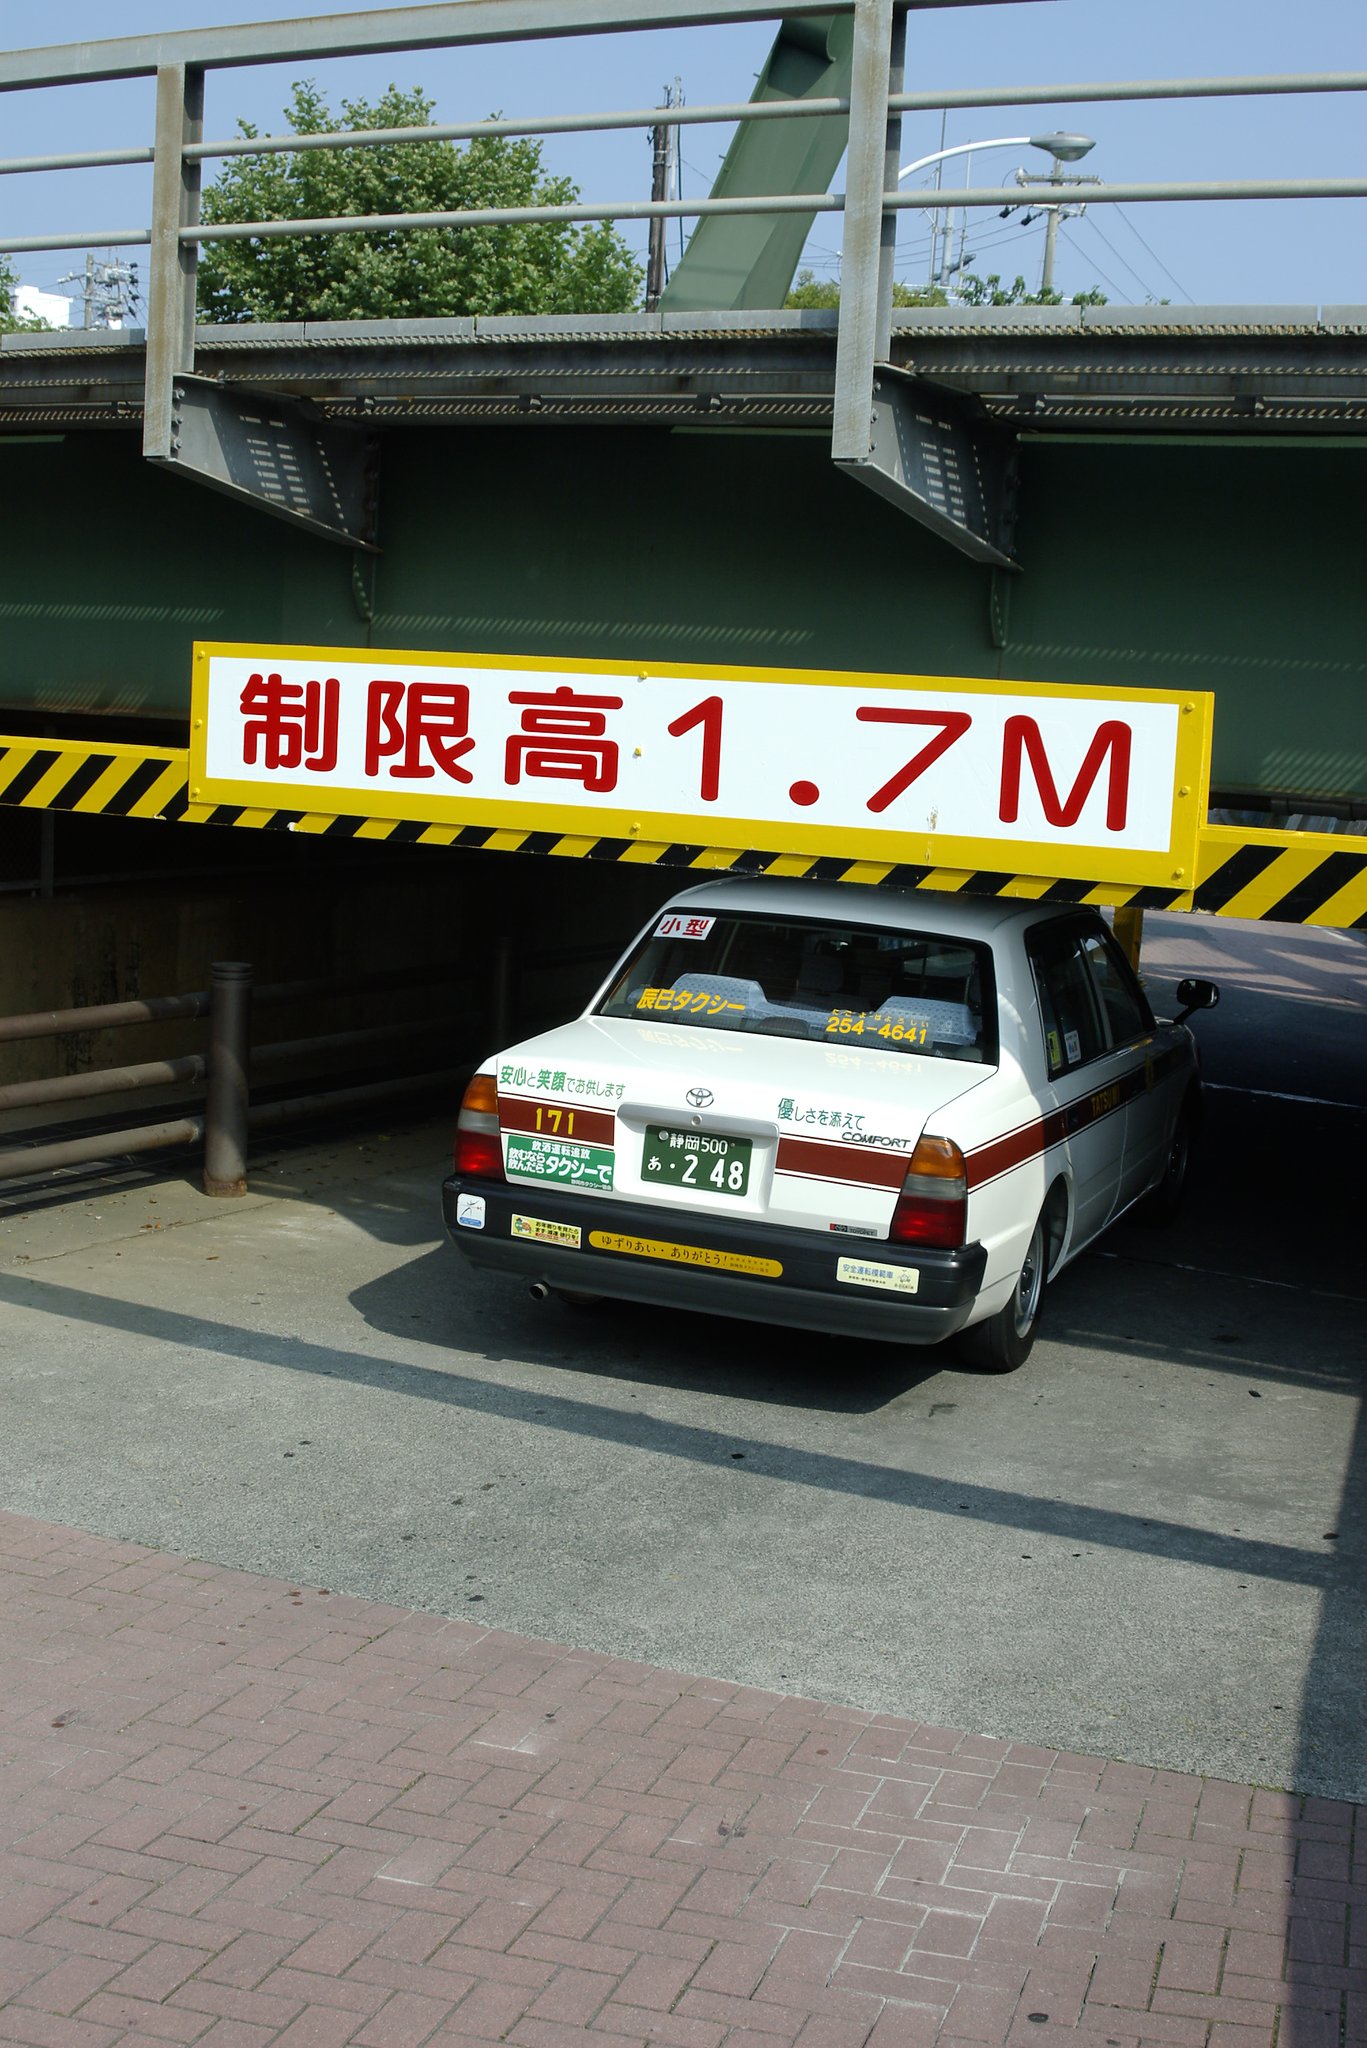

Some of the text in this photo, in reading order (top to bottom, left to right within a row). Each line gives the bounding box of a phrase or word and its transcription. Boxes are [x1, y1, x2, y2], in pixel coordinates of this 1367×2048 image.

[240, 673, 1133, 832] 制限高1.7M
[660, 917, 709, 937] 小型
[636, 987, 746, 1015] 辰巳タクシー
[825, 1016, 927, 1045] 254-4641
[499, 1065, 626, 1100] 安心と笑顔でお供します
[536, 1107, 575, 1135] 171
[778, 1097, 865, 1131] 優しさを添えて
[531, 1140, 591, 1160] 飲酒運転追放
[841, 1131, 911, 1149] COMFORT
[545, 1156, 612, 1184] タクシーで
